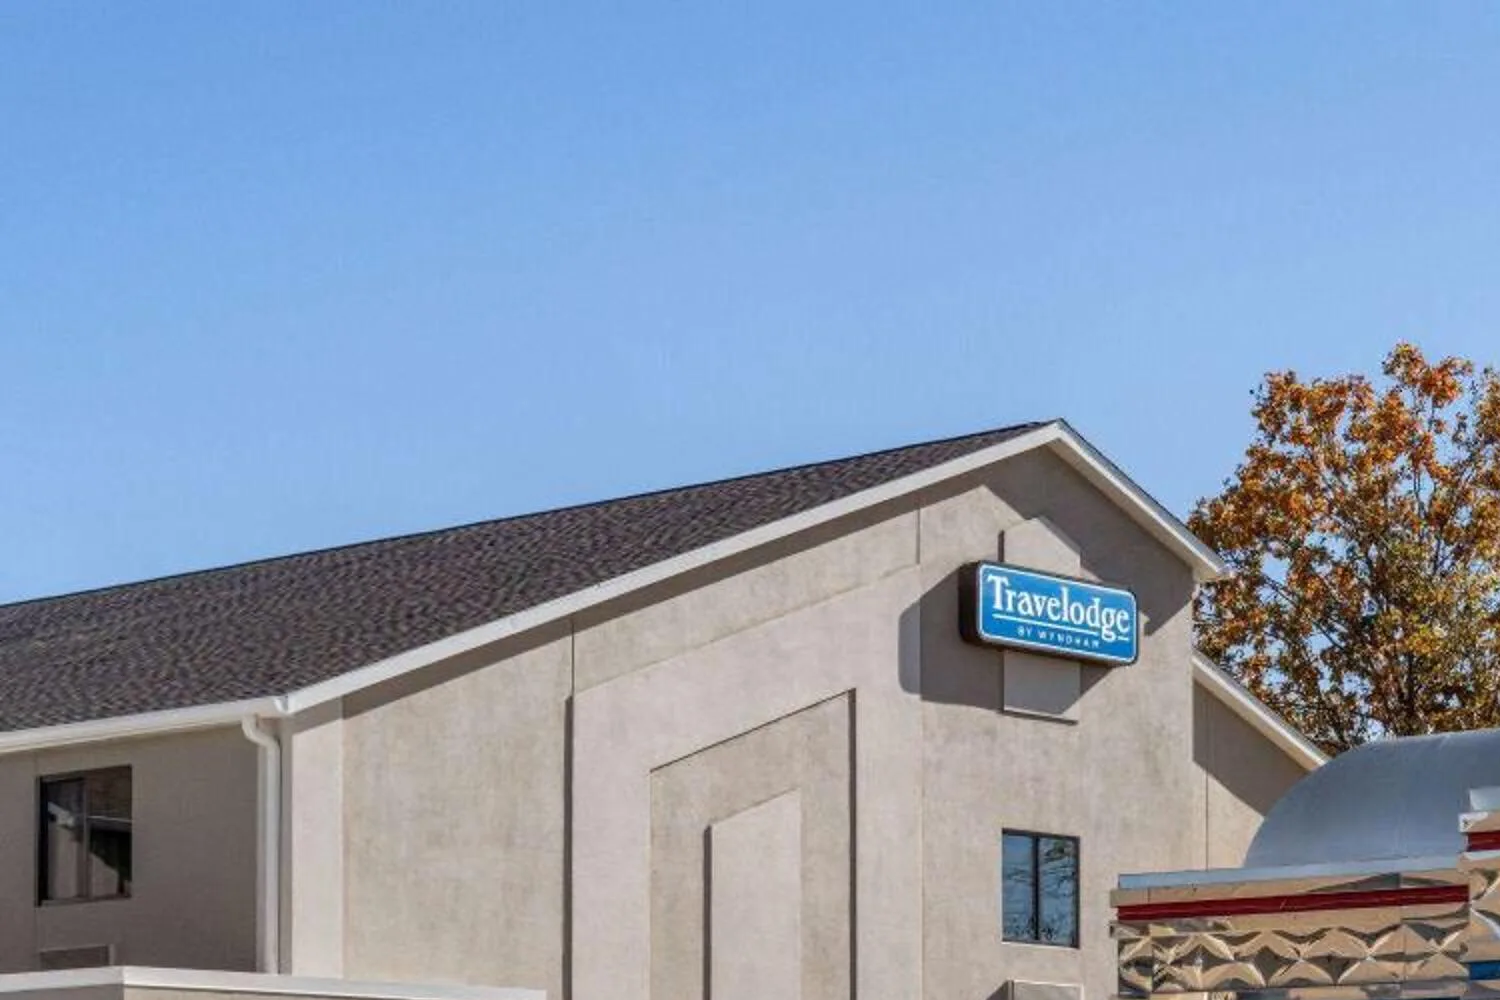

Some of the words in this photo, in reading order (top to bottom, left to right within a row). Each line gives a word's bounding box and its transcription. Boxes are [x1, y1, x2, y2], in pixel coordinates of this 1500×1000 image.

[987, 574, 1129, 641] Travelodge
[1017, 625, 1032, 636] BY
[1038, 630, 1099, 648] WYNDHAM
